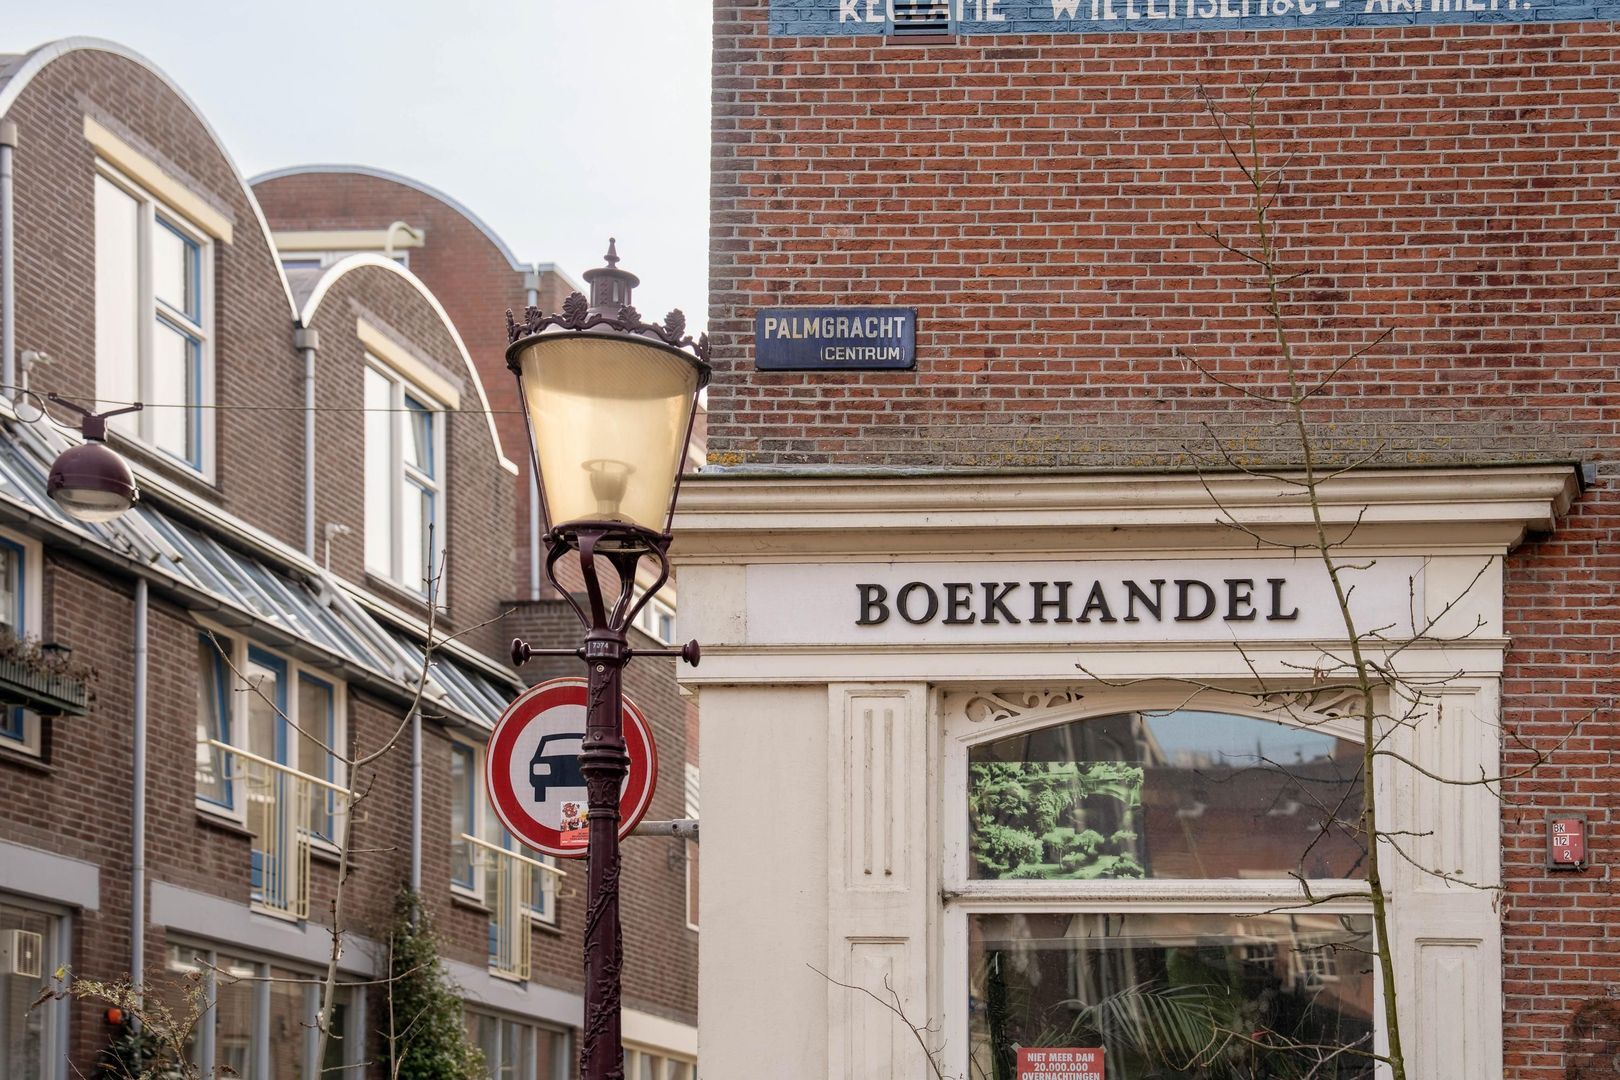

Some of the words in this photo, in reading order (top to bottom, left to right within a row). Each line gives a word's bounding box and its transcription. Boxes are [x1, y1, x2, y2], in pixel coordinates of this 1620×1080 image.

[764, 316, 906, 339] PALMGRACHT
[820, 346, 906, 361] (CENTRUM)
[855, 578, 1299, 625] BOEKHANDEL
[1553, 823, 1565, 833] BK
[1027, 1053, 1046, 1062] NIET
[1049, 1053, 1073, 1062] MEER
[1075, 1053, 1095, 1062] DAN
[1034, 1063, 1089, 1072] 20.000.000
[1021, 1072, 1100, 1080] OVERNACHTINGEN
